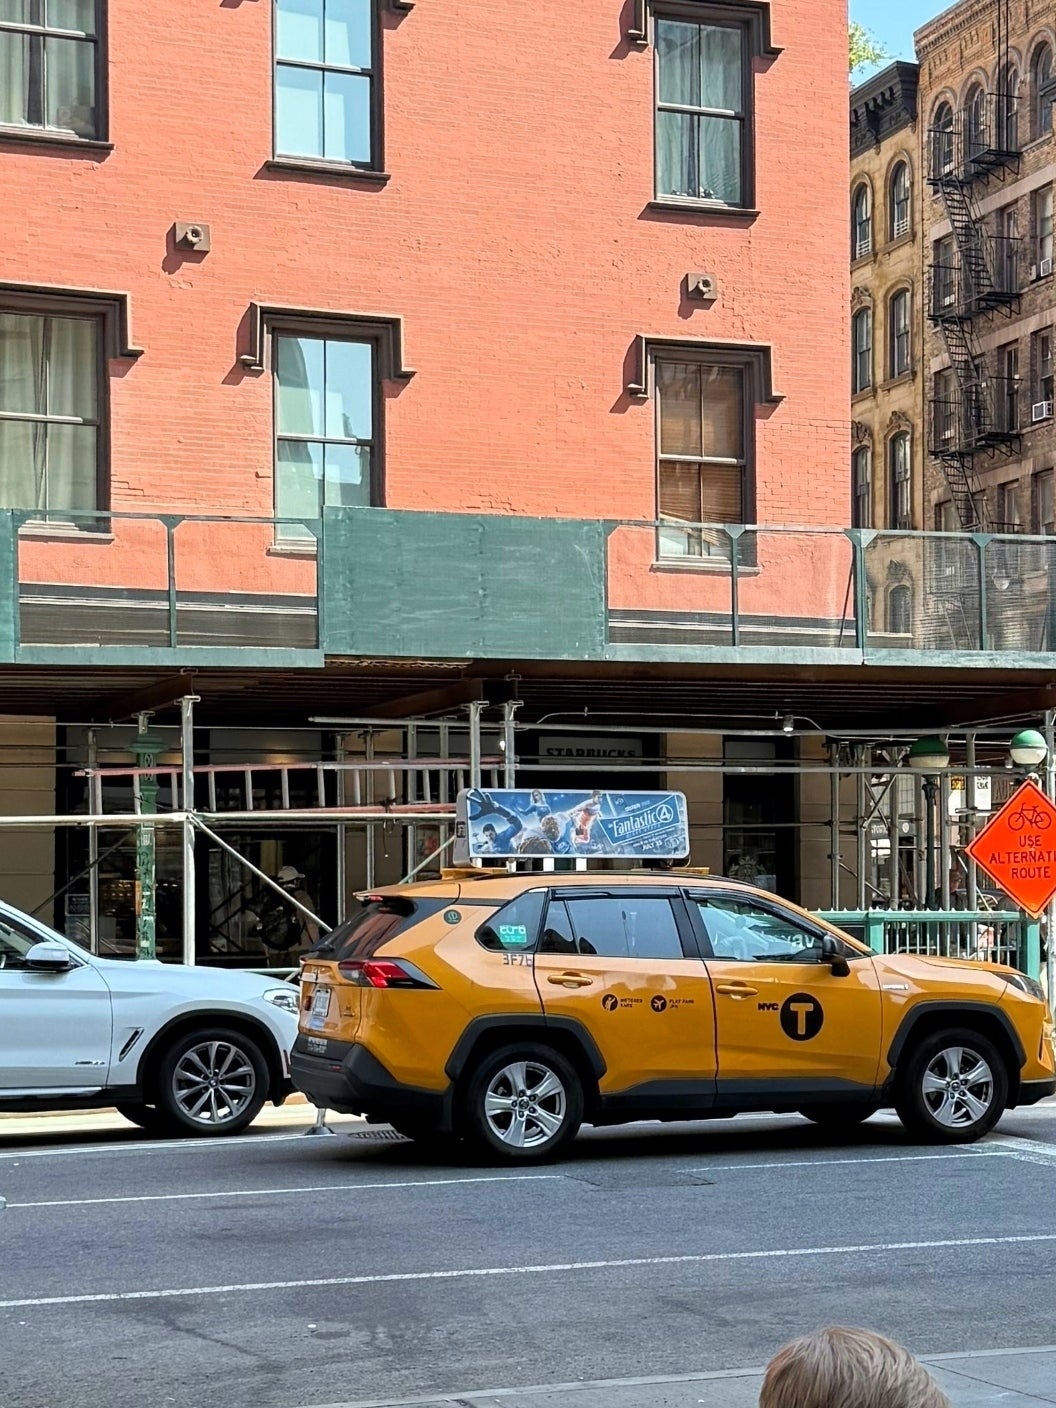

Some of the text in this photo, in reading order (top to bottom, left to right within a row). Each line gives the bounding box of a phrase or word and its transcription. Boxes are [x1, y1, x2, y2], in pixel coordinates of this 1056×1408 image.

[546, 747, 636, 758] STARBUCKS
[613, 810, 657, 837] Fantastic
[1019, 835, 1041, 847] USE
[1011, 866, 1051, 879] ROUTE
[758, 1002, 814, 1035] NYC T
